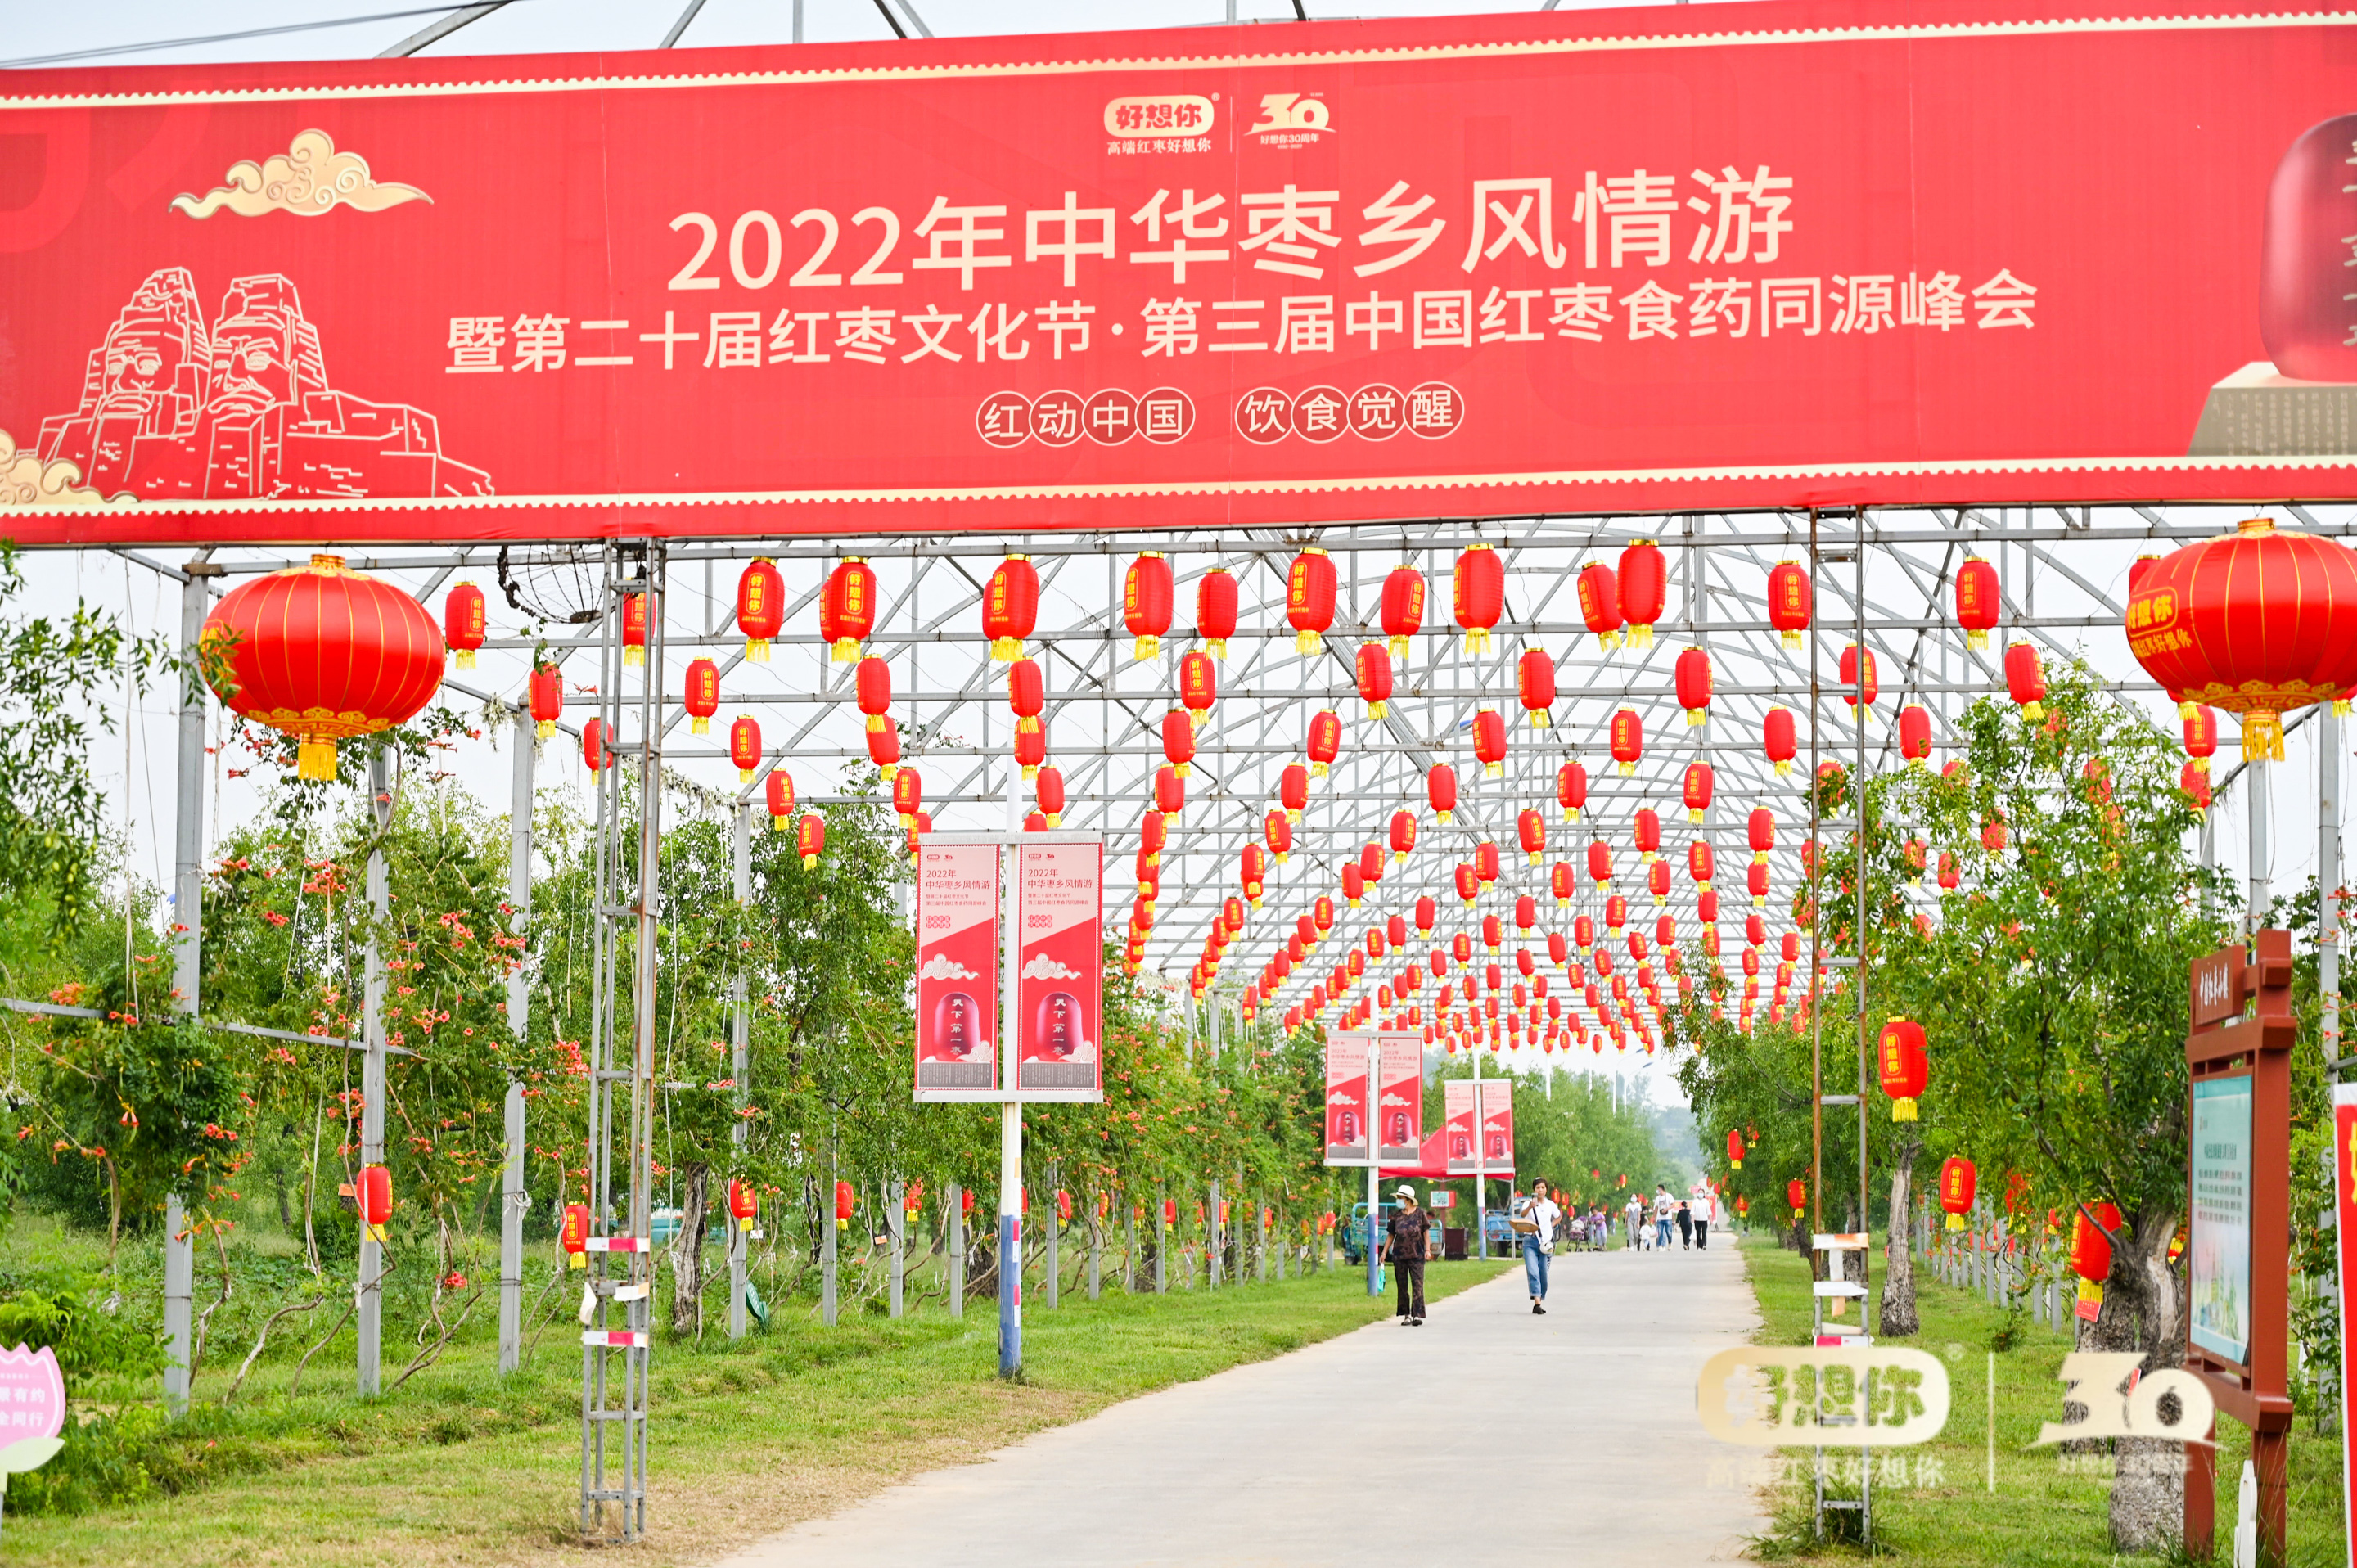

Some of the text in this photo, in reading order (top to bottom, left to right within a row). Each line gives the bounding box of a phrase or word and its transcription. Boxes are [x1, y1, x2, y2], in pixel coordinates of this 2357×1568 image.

[1116, 103, 1201, 129] 好想你
[1252, 92, 1330, 133] 30
[1107, 137, 1212, 155] 高端红枣好想你
[1260, 133, 1319, 145] 好想你30周年
[668, 166, 1794, 291] 2022年中华枣乡风情游
[985, 399, 1183, 438] 红动中国
[1244, 389, 1453, 436] 饮食觉醒
[750, 575, 763, 612] 好想你
[849, 574, 861, 611] 好想你
[994, 574, 1003, 611] 好想你
[1294, 566, 1303, 601] 好想你
[1413, 582, 1422, 614] 好想你
[1580, 582, 1590, 613] 好想你
[1787, 576, 1799, 606] 好想你
[1964, 574, 1973, 606] 好想你
[704, 671, 712, 698] 好想你
[1192, 660, 1201, 687] 好想你
[1325, 720, 1333, 746] 好想你
[926, 869, 956, 878] 2022年
[926, 880, 990, 890] 中华枣乡风情游
[1028, 868, 1057, 877] 2022年
[1028, 879, 1093, 889] 中华枣乡风情游
[1886, 1036, 1898, 1073] 好想你
